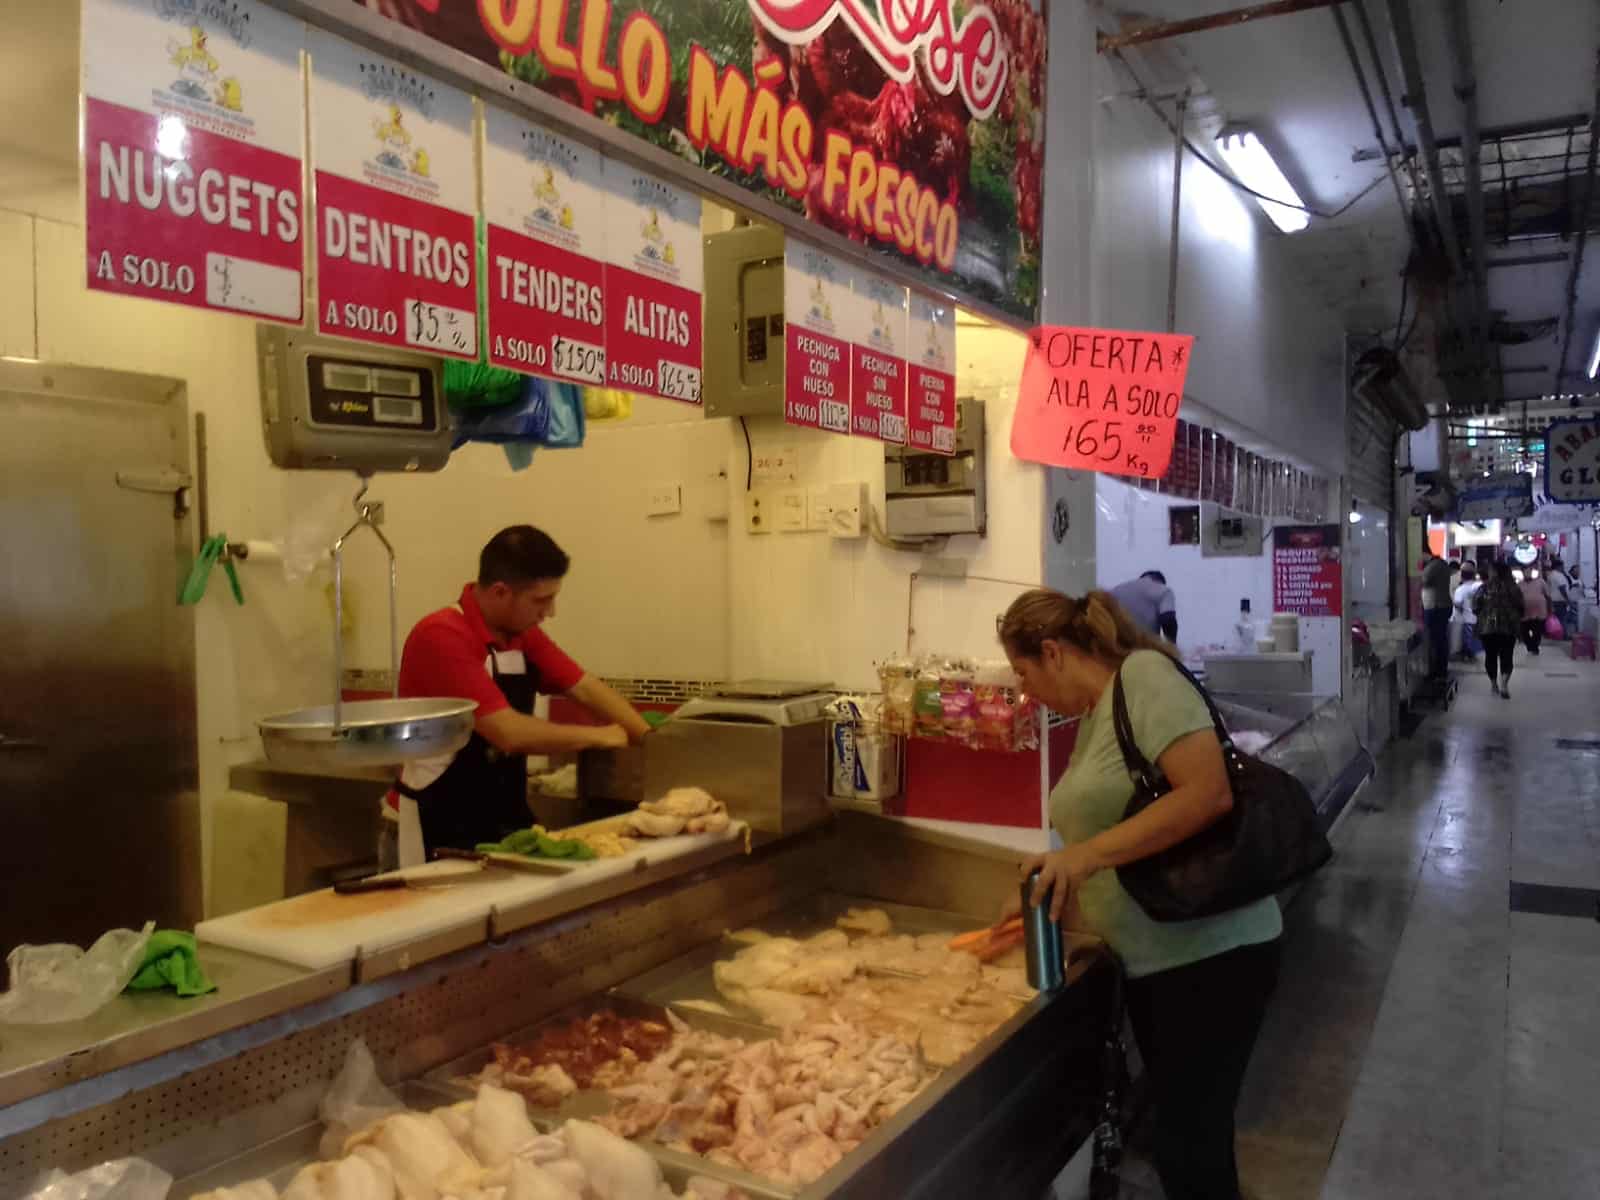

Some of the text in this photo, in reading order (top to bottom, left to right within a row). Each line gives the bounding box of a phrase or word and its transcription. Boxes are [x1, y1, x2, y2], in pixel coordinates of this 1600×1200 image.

[418, 0, 958, 272] OLLO MÁS FRESCO
[98, 140, 300, 243] NUGGETS
[325, 206, 470, 289] DENTROS
[97, 250, 195, 294] A SOLO
[496, 256, 603, 326] TENDERS
[326, 300, 397, 335] A SOLO
[624, 295, 690, 348] ALITAS
[495, 335, 505, 358] A
[507, 337, 547, 367] SOLO
[797, 335, 841, 361] PECHUGA
[1047, 332, 1163, 374] OFERTA
[610, 361, 620, 380] A
[621, 363, 654, 387] SOLO
[809, 358, 829, 377] CON
[862, 354, 898, 377] PECHUGA
[803, 375, 834, 398] HUESO
[873, 375, 886, 391] SIN
[1047, 377, 1180, 418] ALA A SOLO
[787, 401, 794, 418] A
[795, 402, 817, 422] SOLO
[866, 391, 893, 410] HUESO
[859, 416, 878, 433] SOLO
[1063, 419, 1123, 461] 165
[1560, 467, 1600, 485] GL
